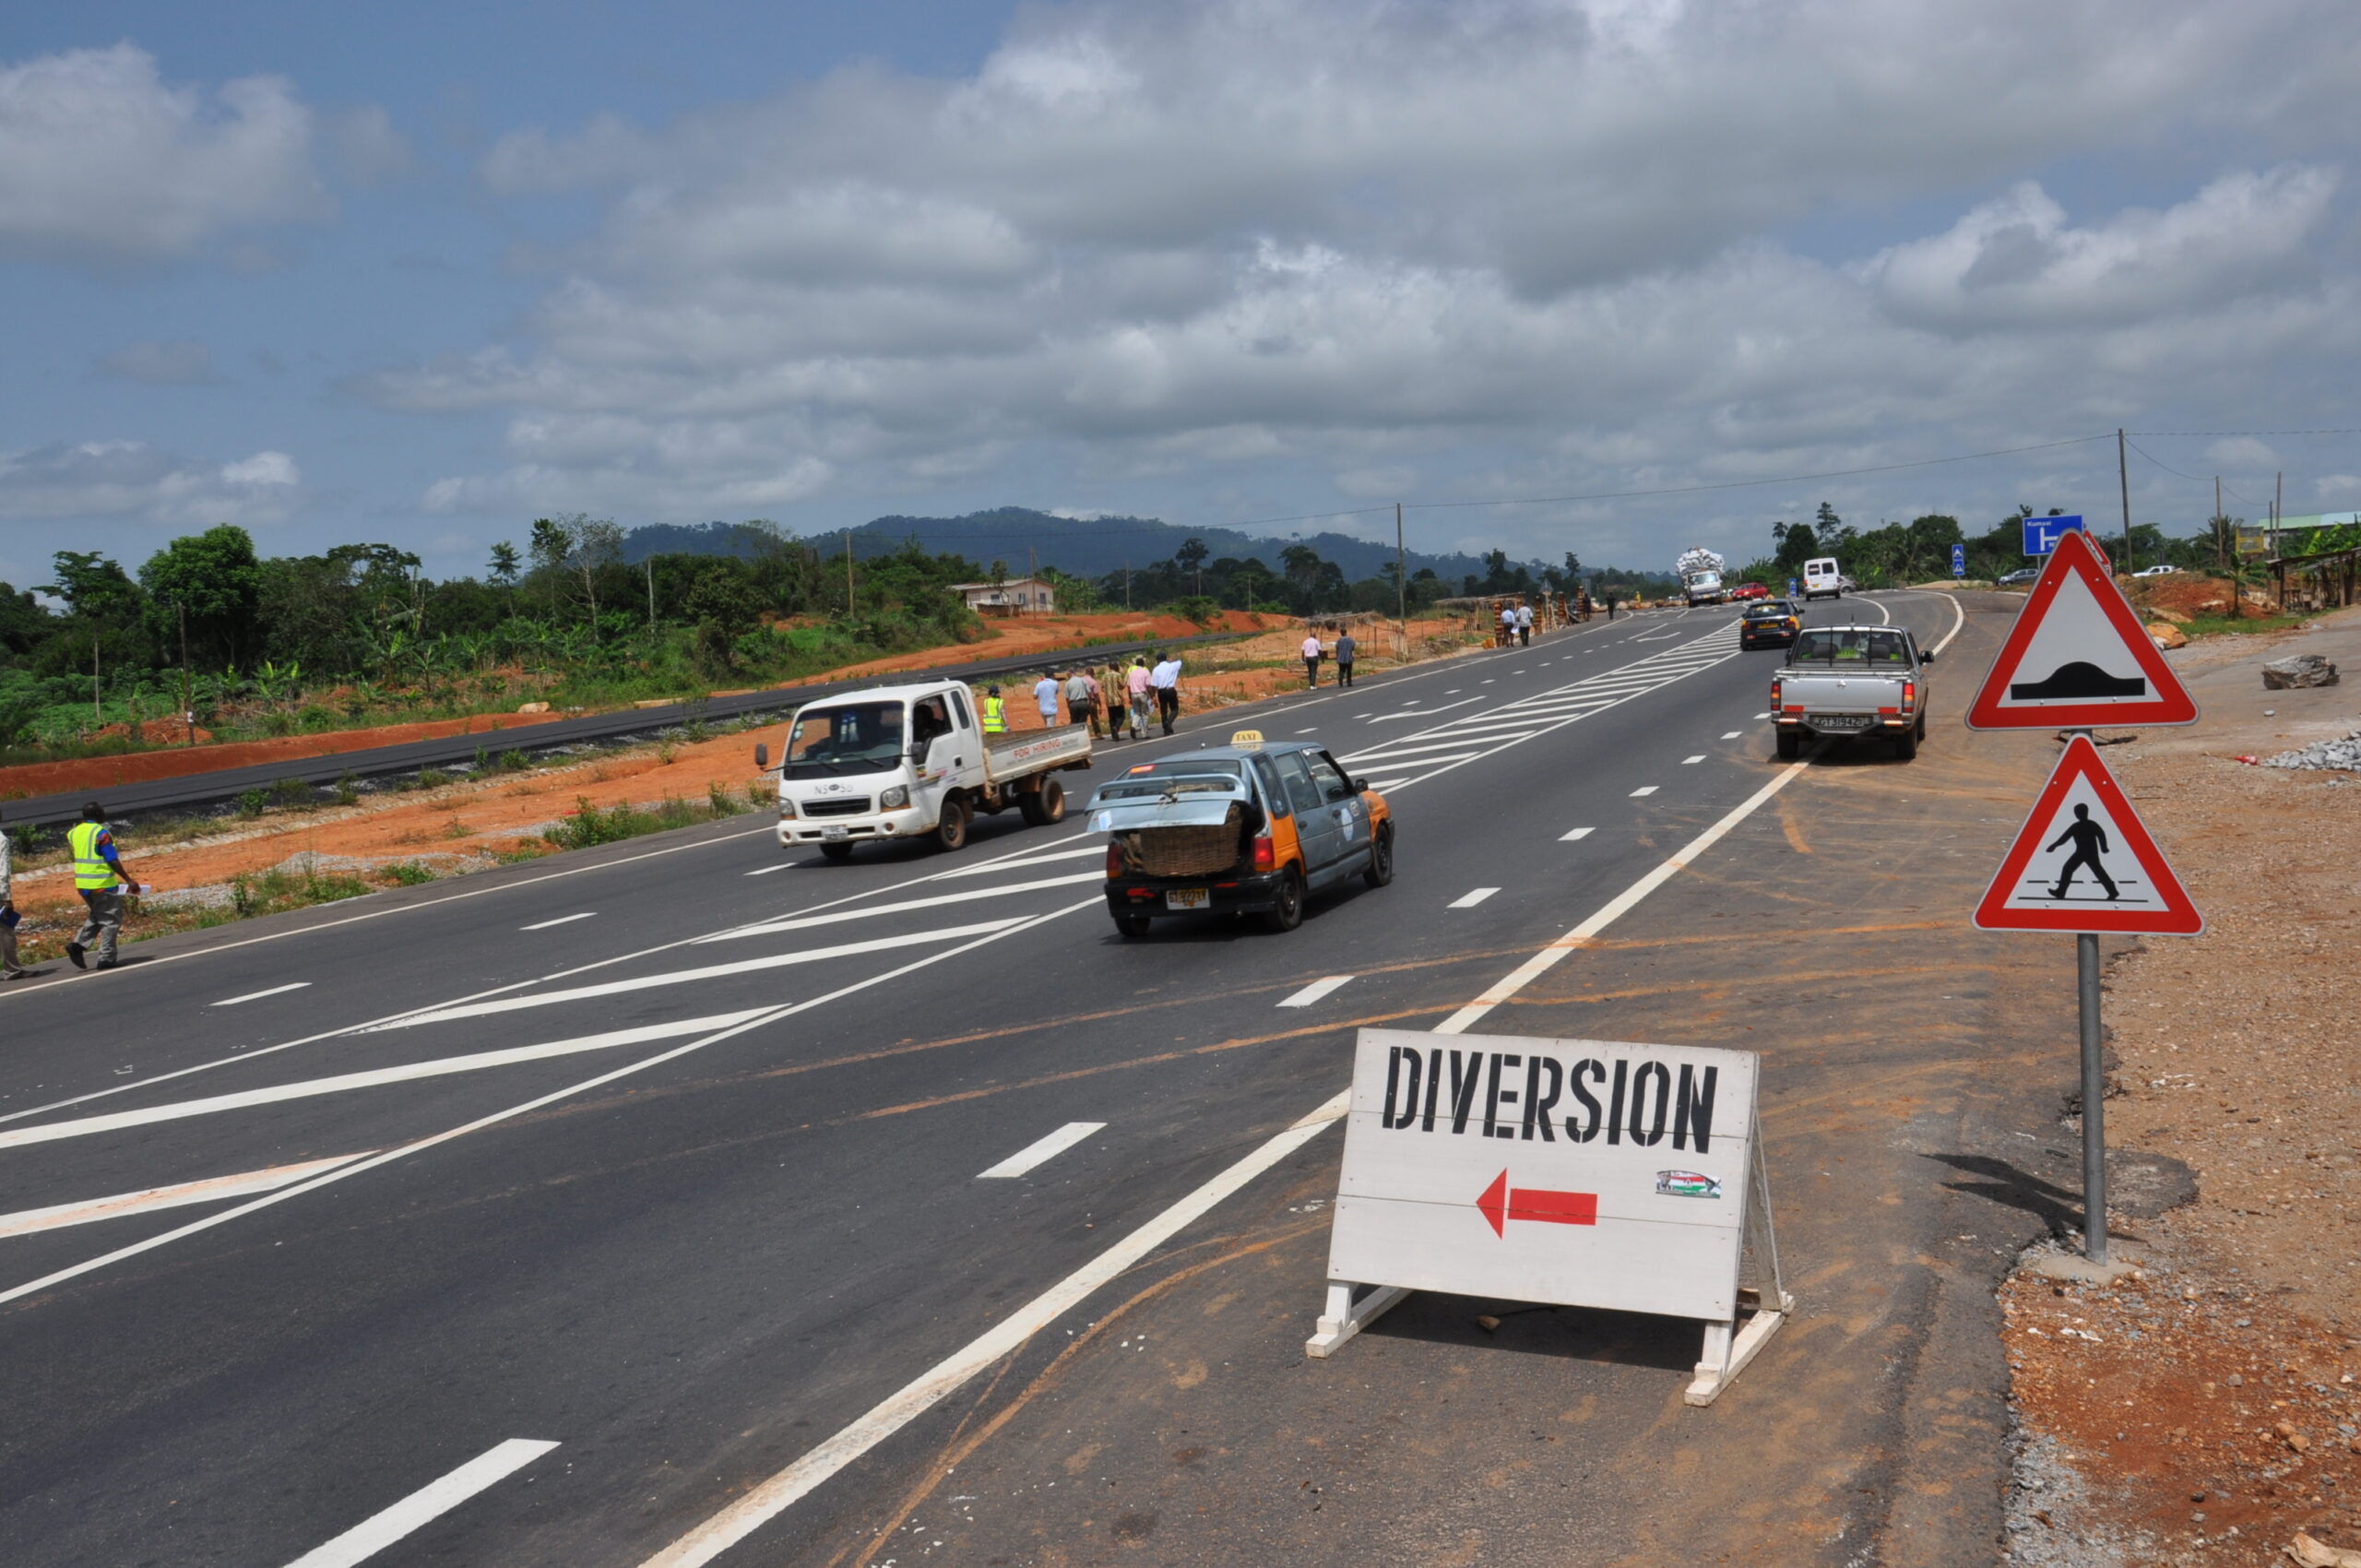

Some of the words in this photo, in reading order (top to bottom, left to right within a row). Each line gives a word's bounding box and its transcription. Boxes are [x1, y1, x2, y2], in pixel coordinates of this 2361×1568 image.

[1236, 733, 1256, 742] TAXI
[1013, 746, 1031, 759] FOR
[1032, 738, 1062, 754] HIRING
[1382, 1045, 1719, 1155] DIVERSION
